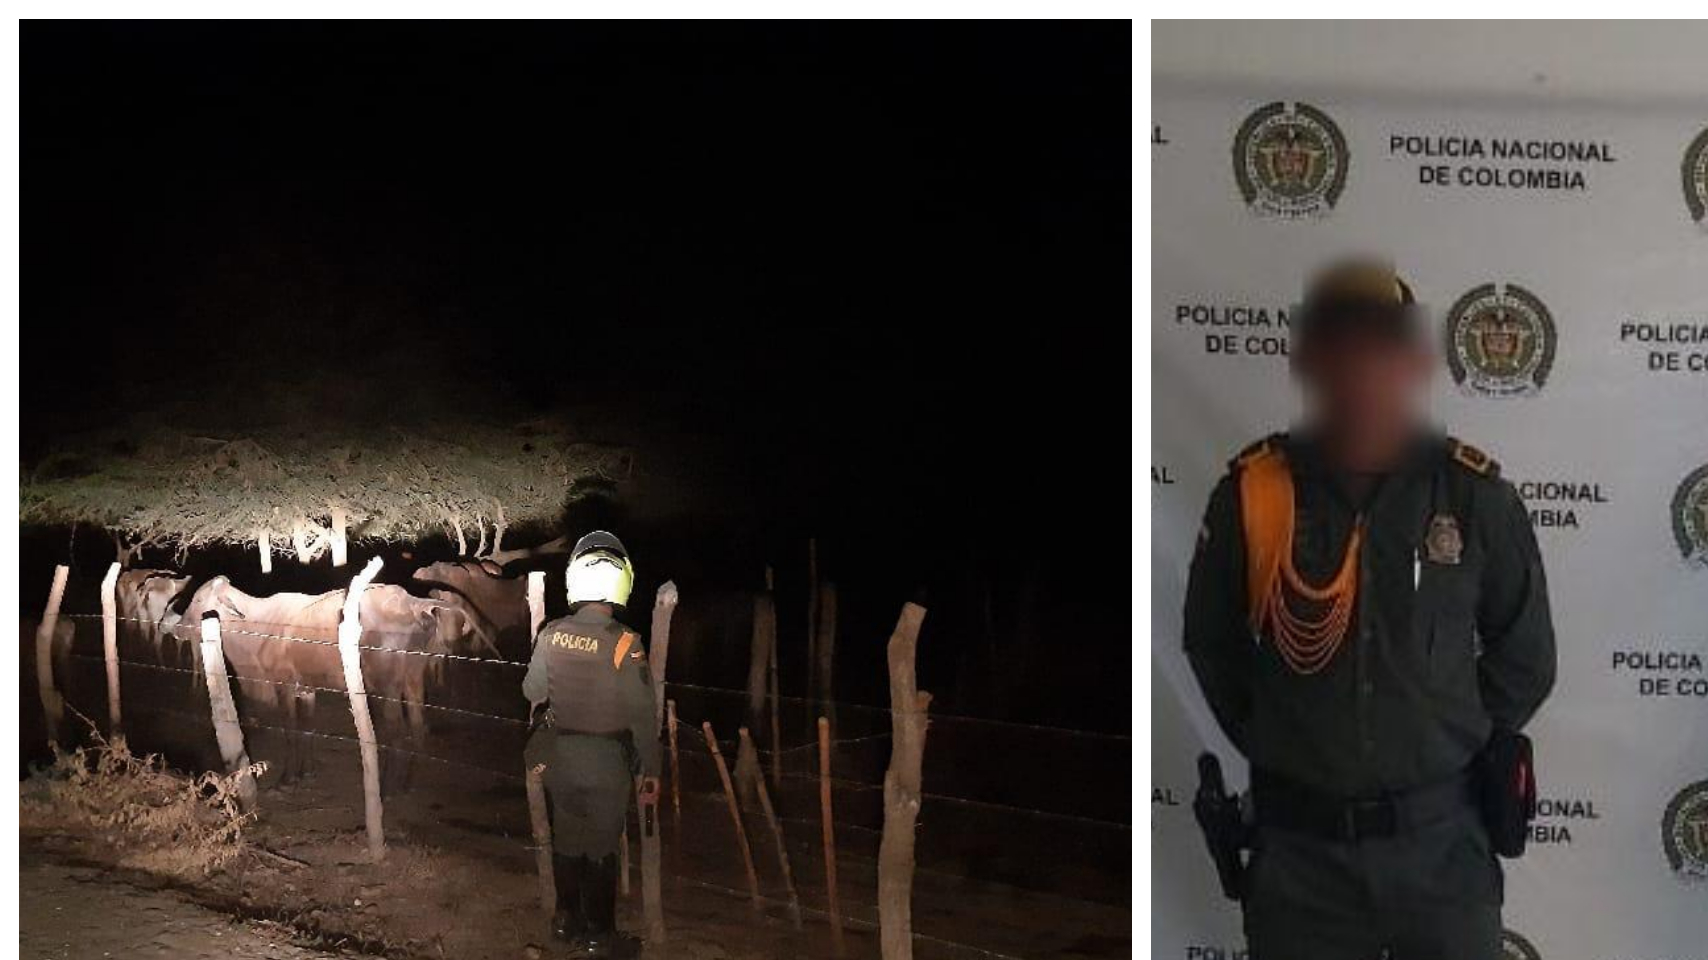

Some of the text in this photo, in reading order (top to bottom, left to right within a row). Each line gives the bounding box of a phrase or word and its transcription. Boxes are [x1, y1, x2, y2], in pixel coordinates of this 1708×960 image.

[1391, 136, 1617, 162] POLICIA NACIONAL
[1420, 166, 1585, 190] DE COLOMBIA
[1176, 306, 1271, 328] POLICIA
[1206, 335, 1238, 354] DE
[1649, 352, 1680, 371] DE
[1519, 482, 1609, 503] CIONAL
[552, 631, 598, 653] POLICIA
[1613, 651, 1702, 671] POLICIA
[1639, 678, 1670, 696] DE
